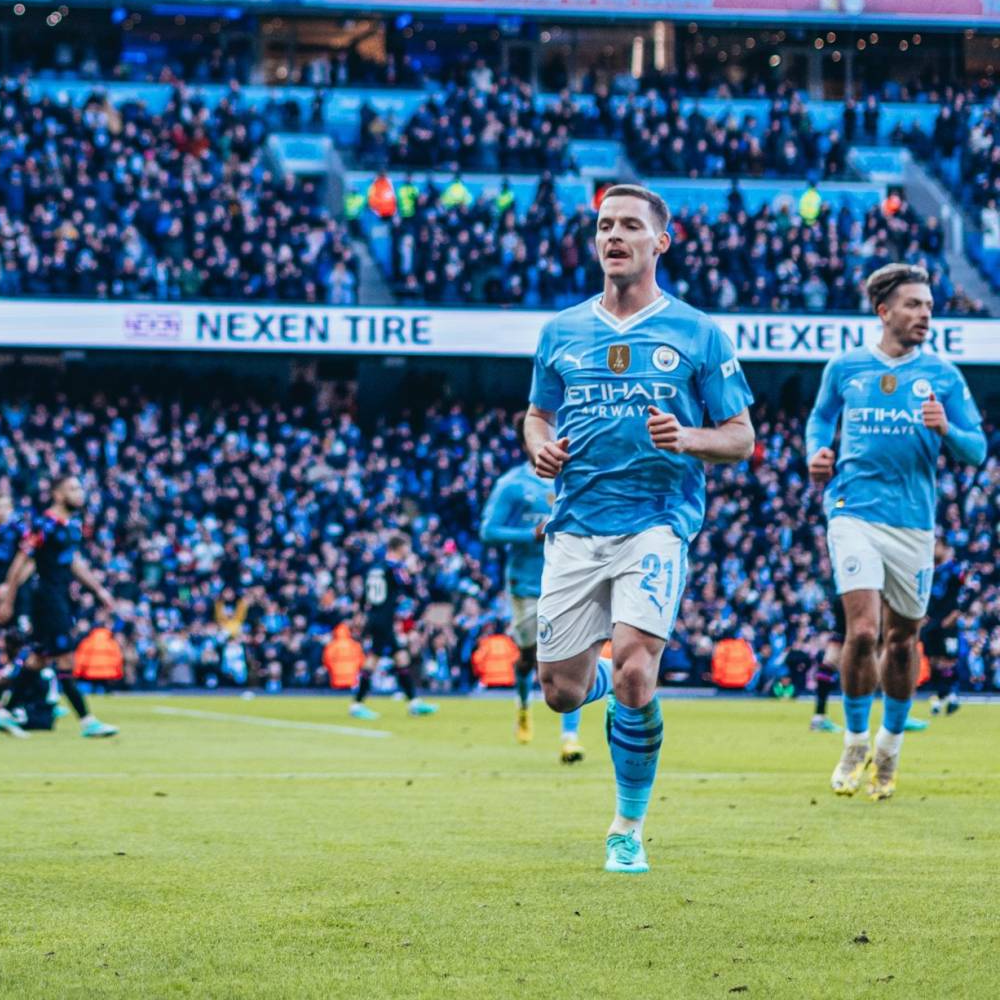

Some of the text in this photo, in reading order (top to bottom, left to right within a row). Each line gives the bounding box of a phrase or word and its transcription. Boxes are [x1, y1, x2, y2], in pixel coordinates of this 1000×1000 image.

[196, 312, 330, 343] NEXEN
[343, 314, 433, 345] TIRE
[736, 323, 864, 351] NEXEN
[567, 382, 677, 404] ETIHAD
[581, 405, 647, 418] AIRWAY
[640, 553, 673, 597] 21
